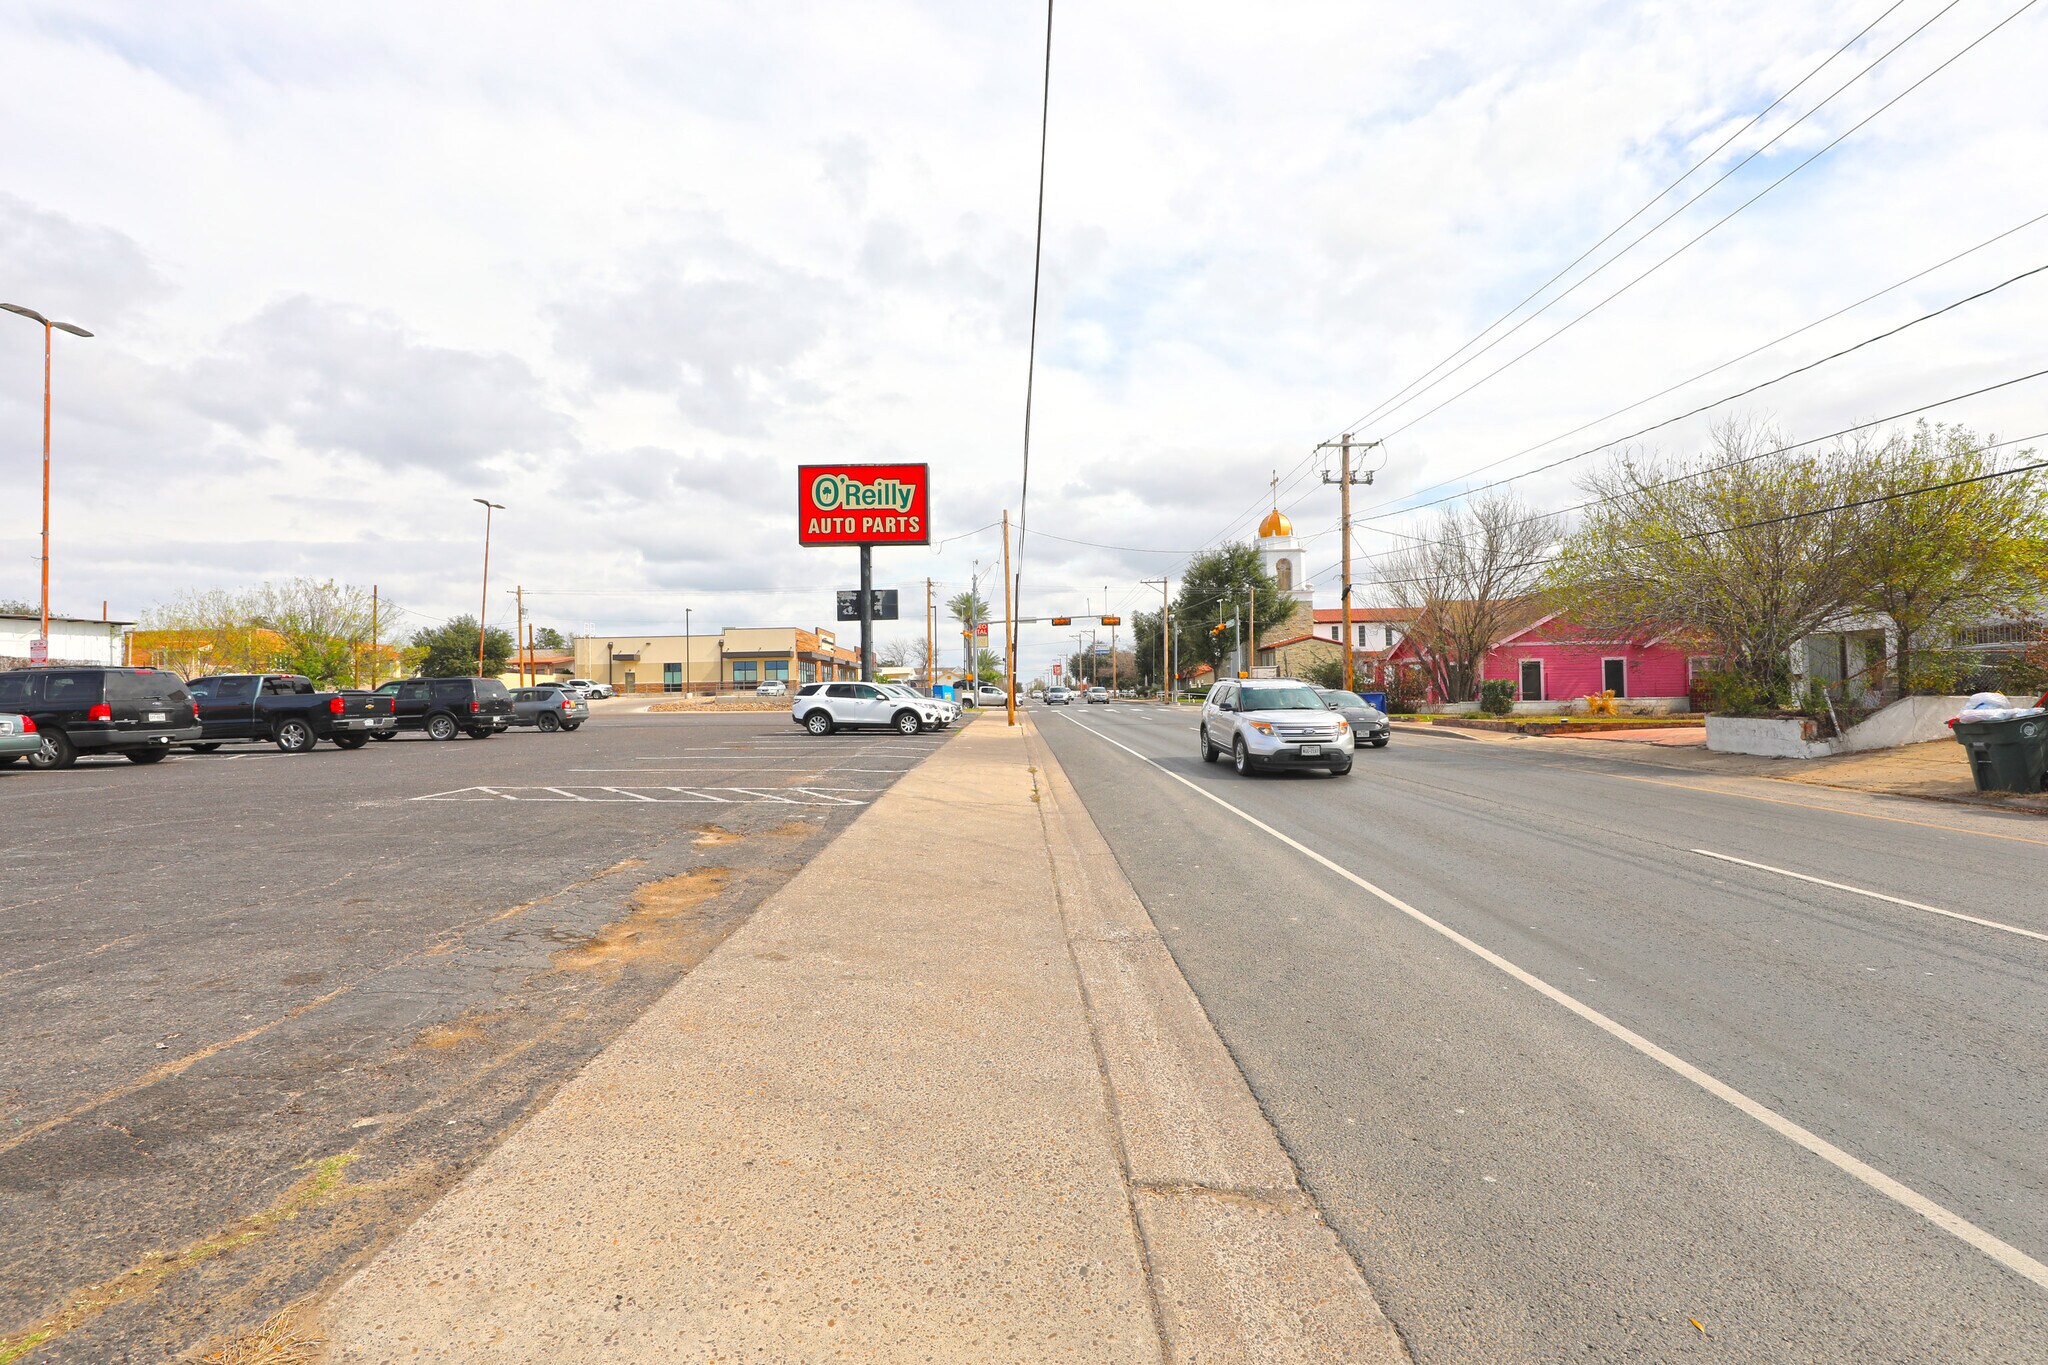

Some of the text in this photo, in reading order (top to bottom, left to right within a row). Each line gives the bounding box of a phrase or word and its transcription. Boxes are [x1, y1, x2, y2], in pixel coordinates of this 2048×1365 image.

[815, 477, 912, 510] O'Reilly
[808, 516, 920, 534] AUTO PARTS
